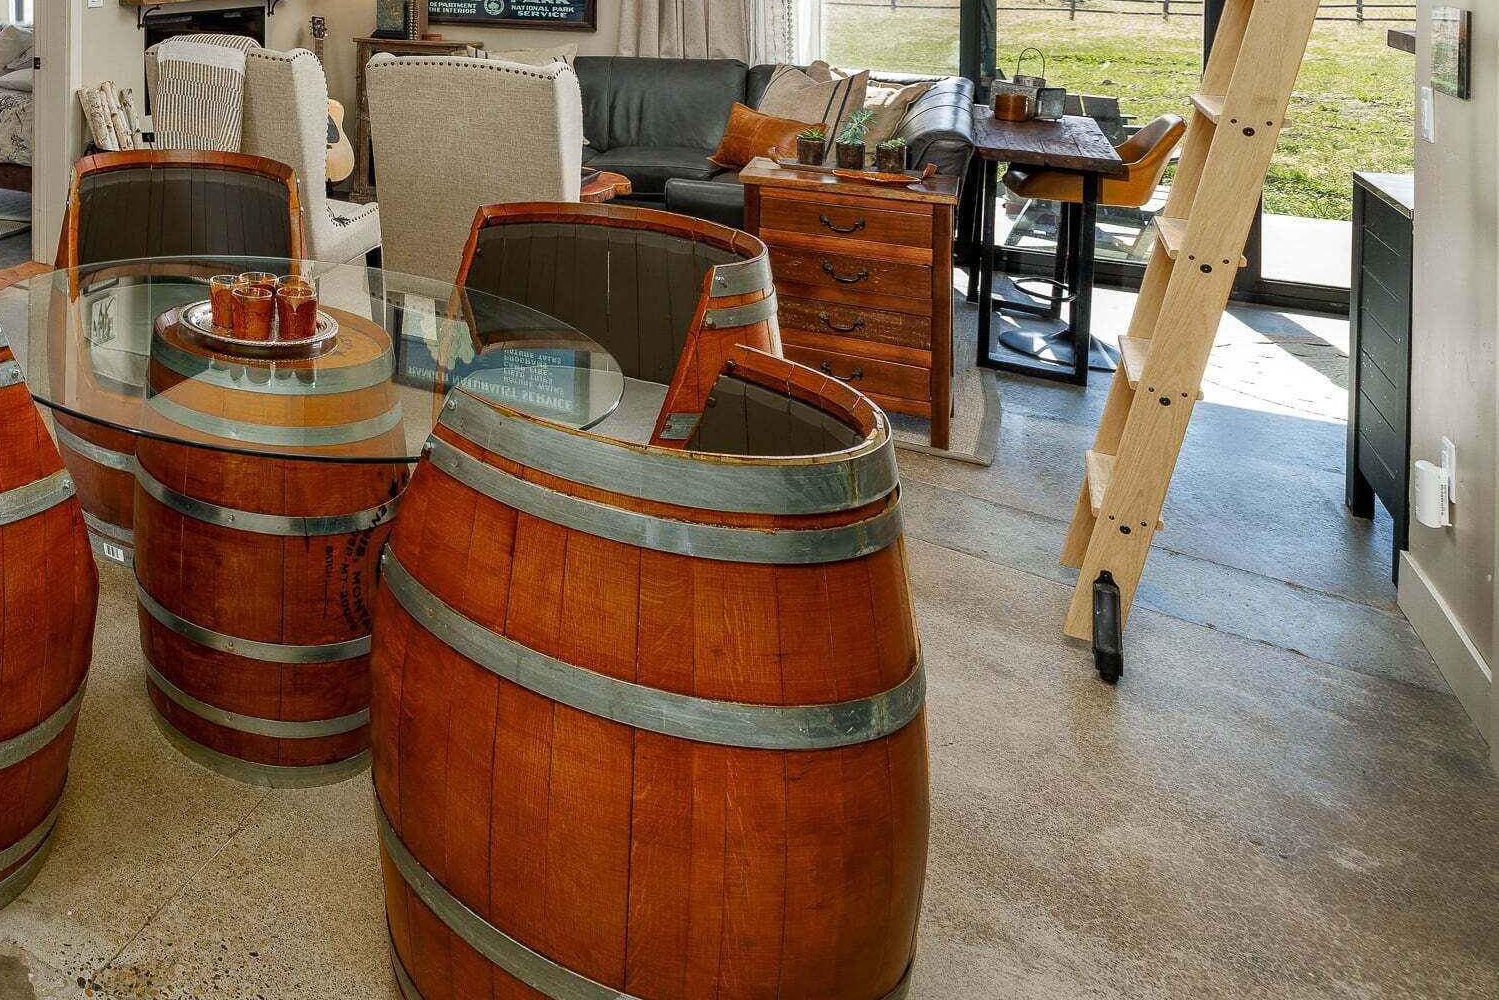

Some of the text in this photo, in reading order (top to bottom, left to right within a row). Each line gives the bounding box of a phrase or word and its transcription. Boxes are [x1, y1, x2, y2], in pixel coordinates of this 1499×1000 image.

[429, 1, 477, 9] DEPARTMENT
[511, 4, 549, 12] NATIONAL
[517, 10, 568, 18] SERVICE
